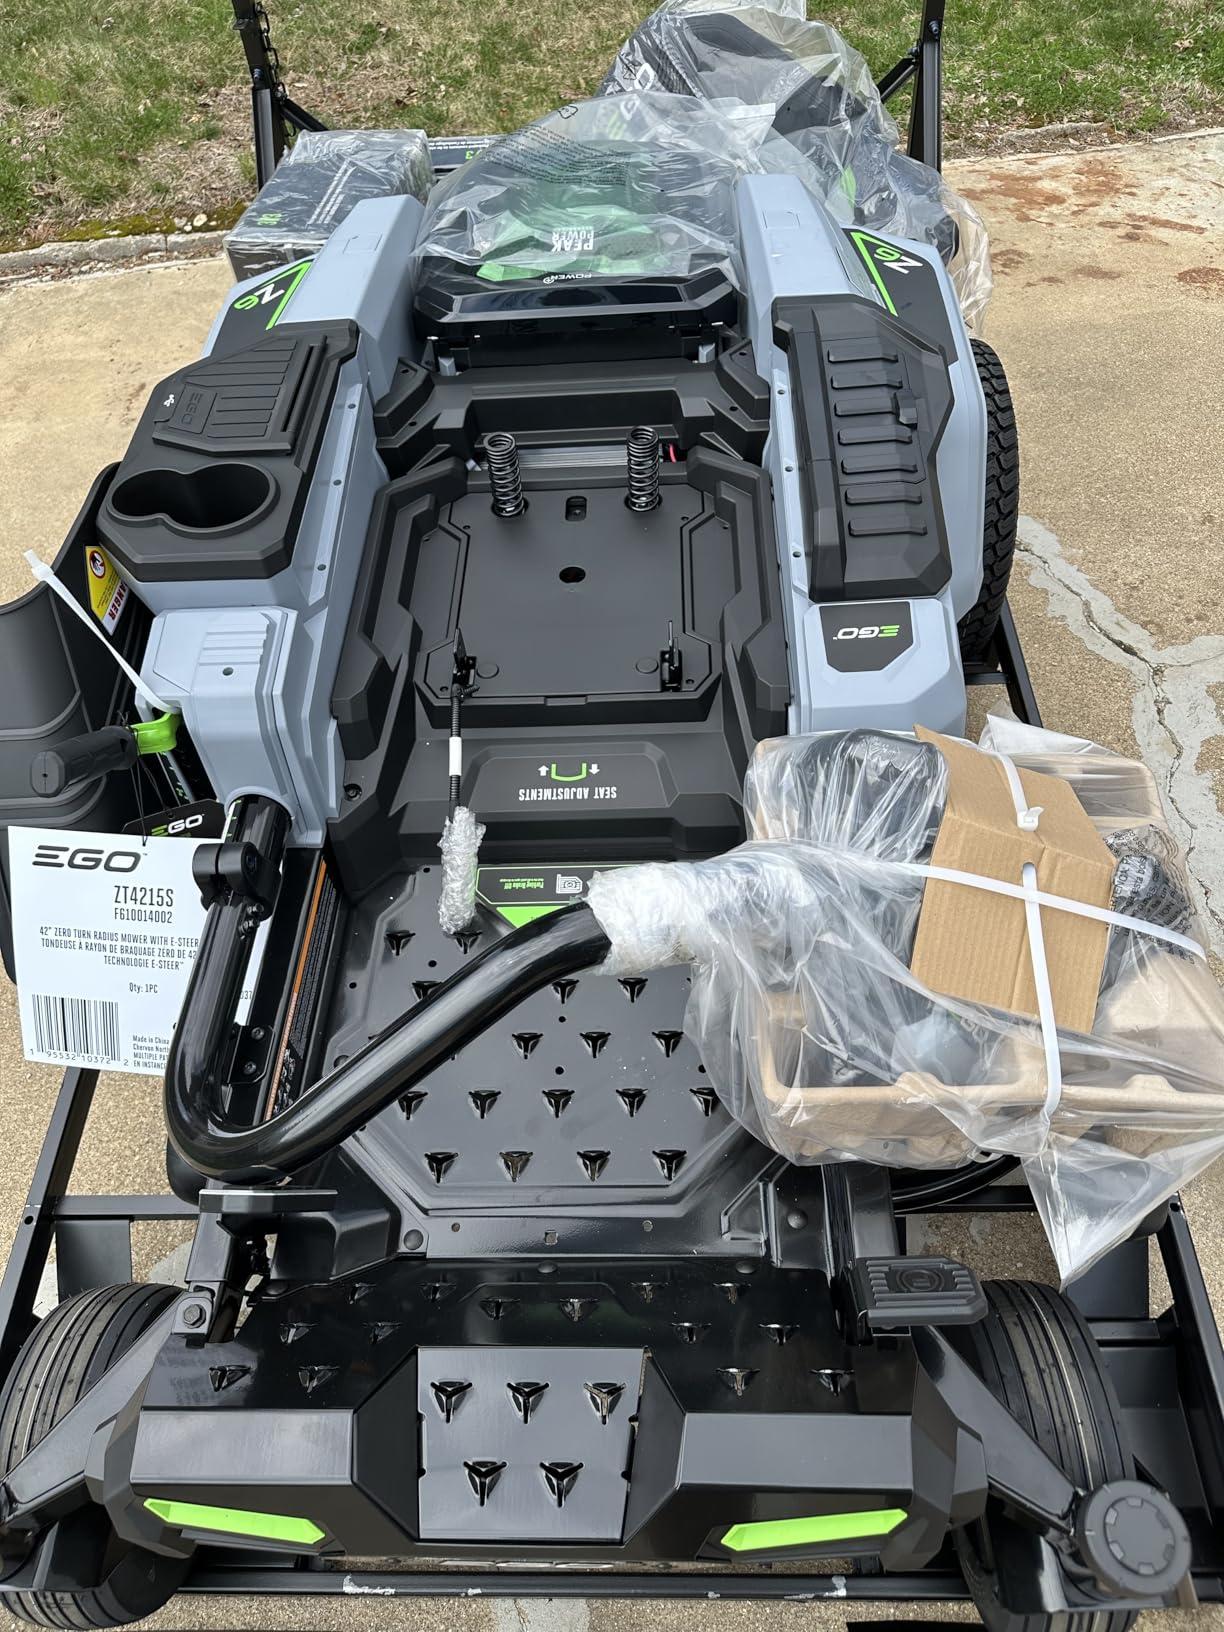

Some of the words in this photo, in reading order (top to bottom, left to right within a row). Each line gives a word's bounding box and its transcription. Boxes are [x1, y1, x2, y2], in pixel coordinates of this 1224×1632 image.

[552, 230, 594, 241] POWER
[551, 239, 594, 252] PEAK
[550, 272, 592, 281] POWER
[108, 580, 127, 621] ANGER
[837, 624, 900, 640] EGO
[518, 787, 589, 801] ADJUSTMENTS
[593, 786, 617, 799] SEAT
[151, 814, 203, 837] EGO
[31, 844, 142, 873] EGO
[113, 885, 175, 908] ZT4215S
[113, 907, 173, 924] F610014002
[54, 927, 72, 938] ZERO
[73, 928, 92, 940] TURN
[93, 930, 119, 942] RADIUS
[120, 933, 148, 945] MOWER
[150, 935, 169, 946] WITH
[170, 936, 200, 948] E-STEER
[41, 937, 77, 950] TONDEUSE
[78, 938, 84, 951] À
[84, 941, 107, 953] RAYON
[109, 943, 118, 954] DE
[120, 945, 156, 957] BRAQUAGE
[157, 946, 175, 959] ZÉRO
[177, 949, 187, 960] DE
[103, 955, 150, 968] TECHNOLOGIE
[128, 981, 144, 995] Qty:
[145, 983, 159, 994] 1PC
[132, 1034, 147, 1043] Made
[148, 1035, 153, 1044] in
[29, 1048, 35, 1056] 1
[46, 1050, 77, 1061] 95532
[81, 1054, 112, 1065] 10372
[123, 1059, 129, 1067] 2
[133, 1051, 158, 1061] MULTIPLE
[133, 1059, 141, 1068] EN
